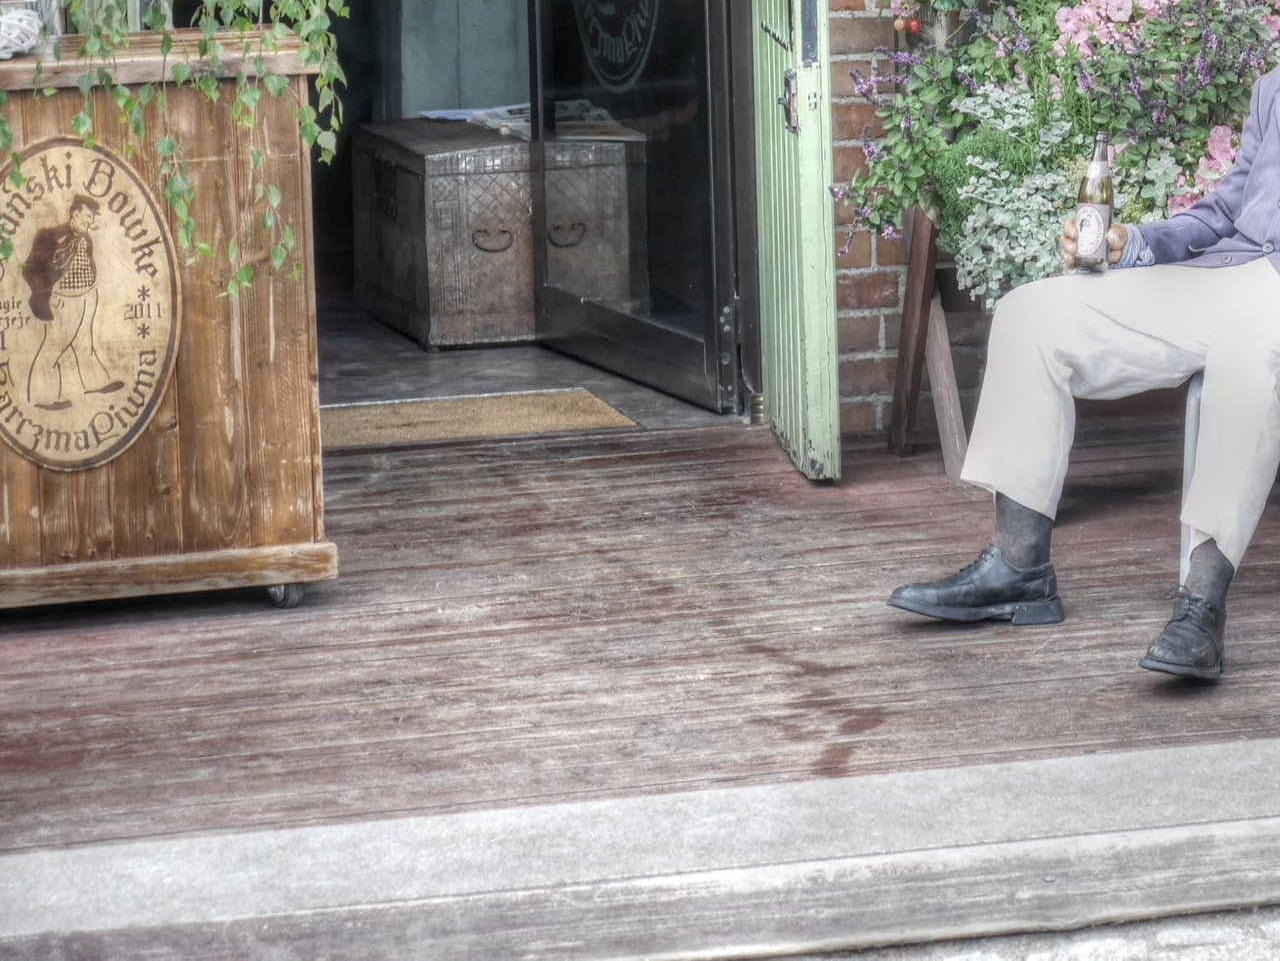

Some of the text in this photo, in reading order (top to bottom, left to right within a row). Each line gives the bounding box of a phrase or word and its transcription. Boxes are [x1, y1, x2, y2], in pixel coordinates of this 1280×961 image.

[83, 158, 163, 279] Bowke
[123, 302, 162, 320] 2011
[88, 348, 158, 448] Piwna
